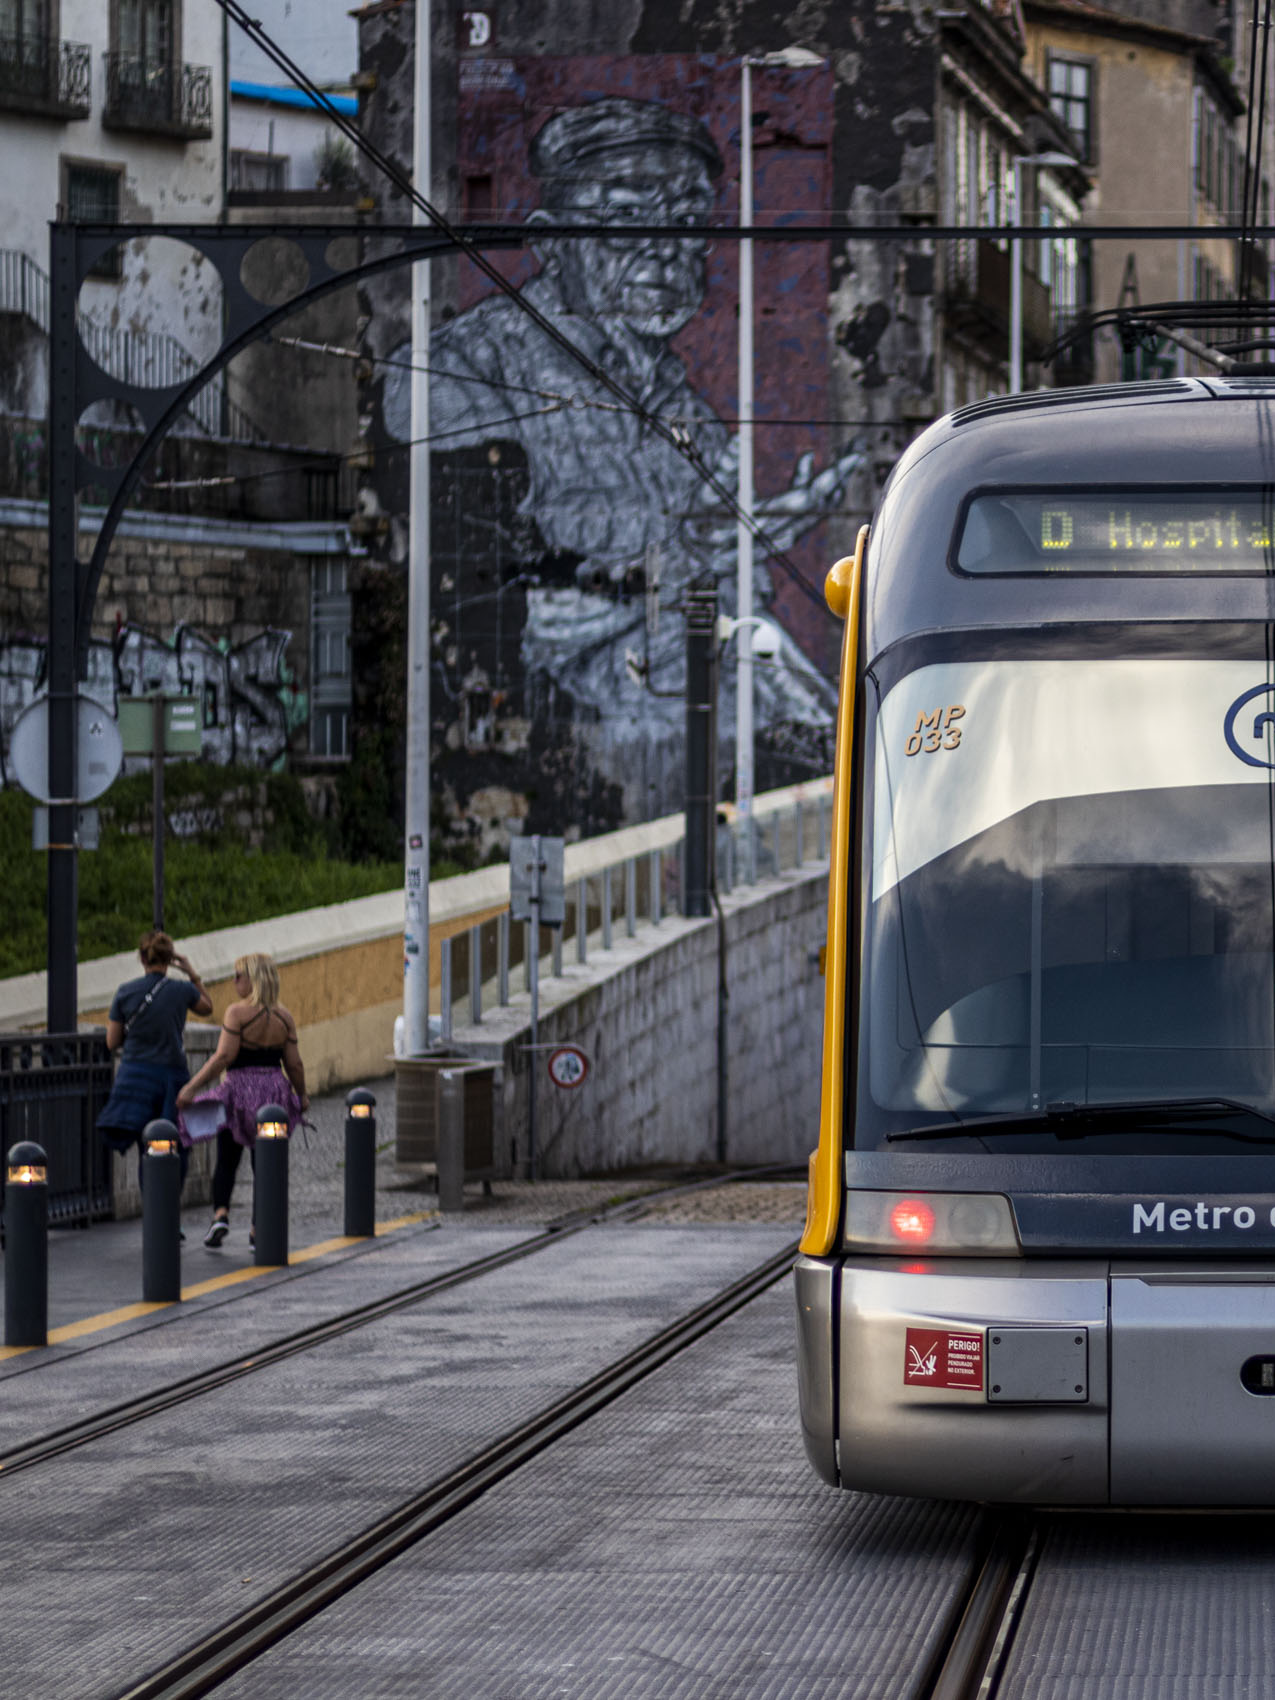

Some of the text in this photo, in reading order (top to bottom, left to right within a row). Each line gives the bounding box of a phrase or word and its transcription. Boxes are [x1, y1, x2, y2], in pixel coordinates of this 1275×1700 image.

[1042, 511, 1073, 549] D
[914, 704, 966, 733] MP
[904, 728, 962, 757] 033
[1132, 1201, 1256, 1234] Metro
[948, 1339, 980, 1352] PERIGO!
